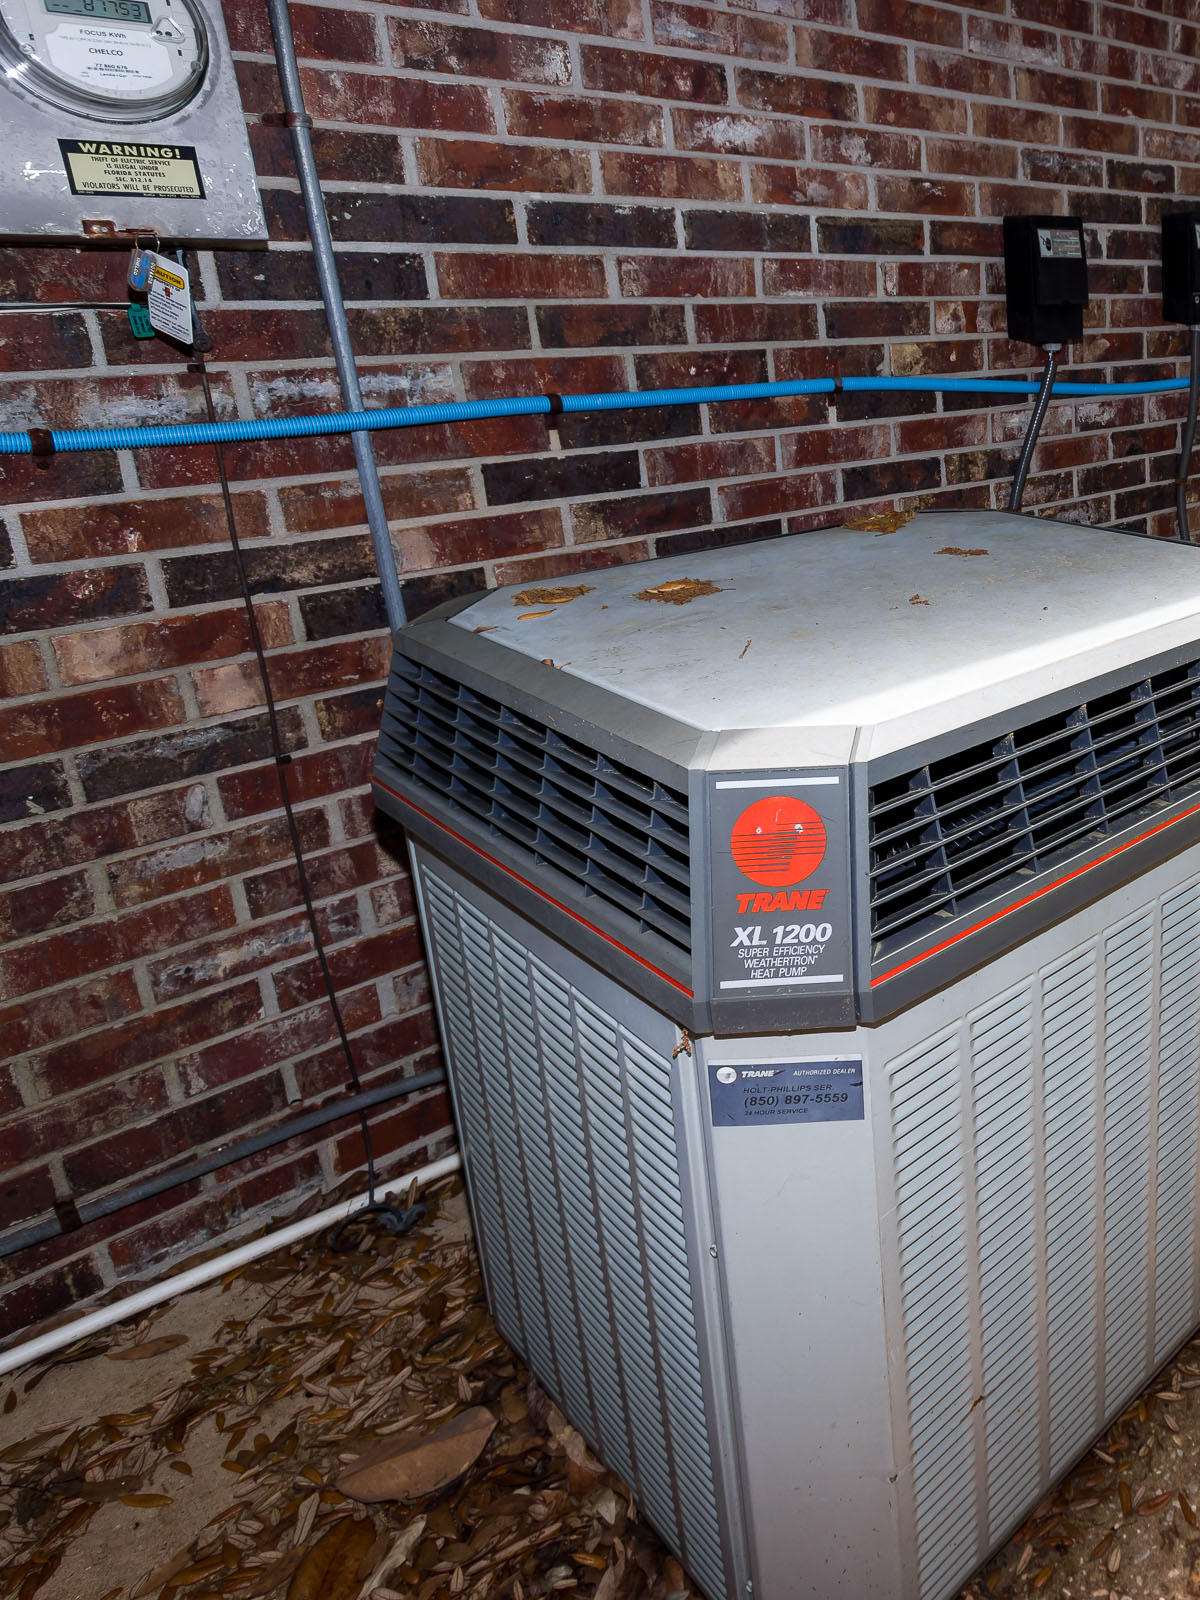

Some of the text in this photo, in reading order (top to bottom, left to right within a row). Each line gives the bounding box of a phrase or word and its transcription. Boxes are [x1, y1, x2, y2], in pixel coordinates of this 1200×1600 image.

[80, 29, 107, 37] FOCUS
[88, 47, 124, 56] CHELCO
[78, 142, 181, 159] WARNING!
[82, 182, 120, 190] VIOLATORS
[123, 183, 140, 191] WILL
[153, 185, 194, 193] PROSECUTED
[736, 889, 827, 914] TRANE
[730, 922, 833, 947] XL 1200
[738, 944, 825, 958] SUPER EFFICIENCY
[744, 956, 816, 969] WEATHERTRON
[750, 966, 808, 979] HEAT PUMP
[741, 1069, 775, 1078] TRANE
[743, 1085, 811, 1094] HOLT-PHILLIPS
[744, 1092, 848, 1108] (850) 897-5559
